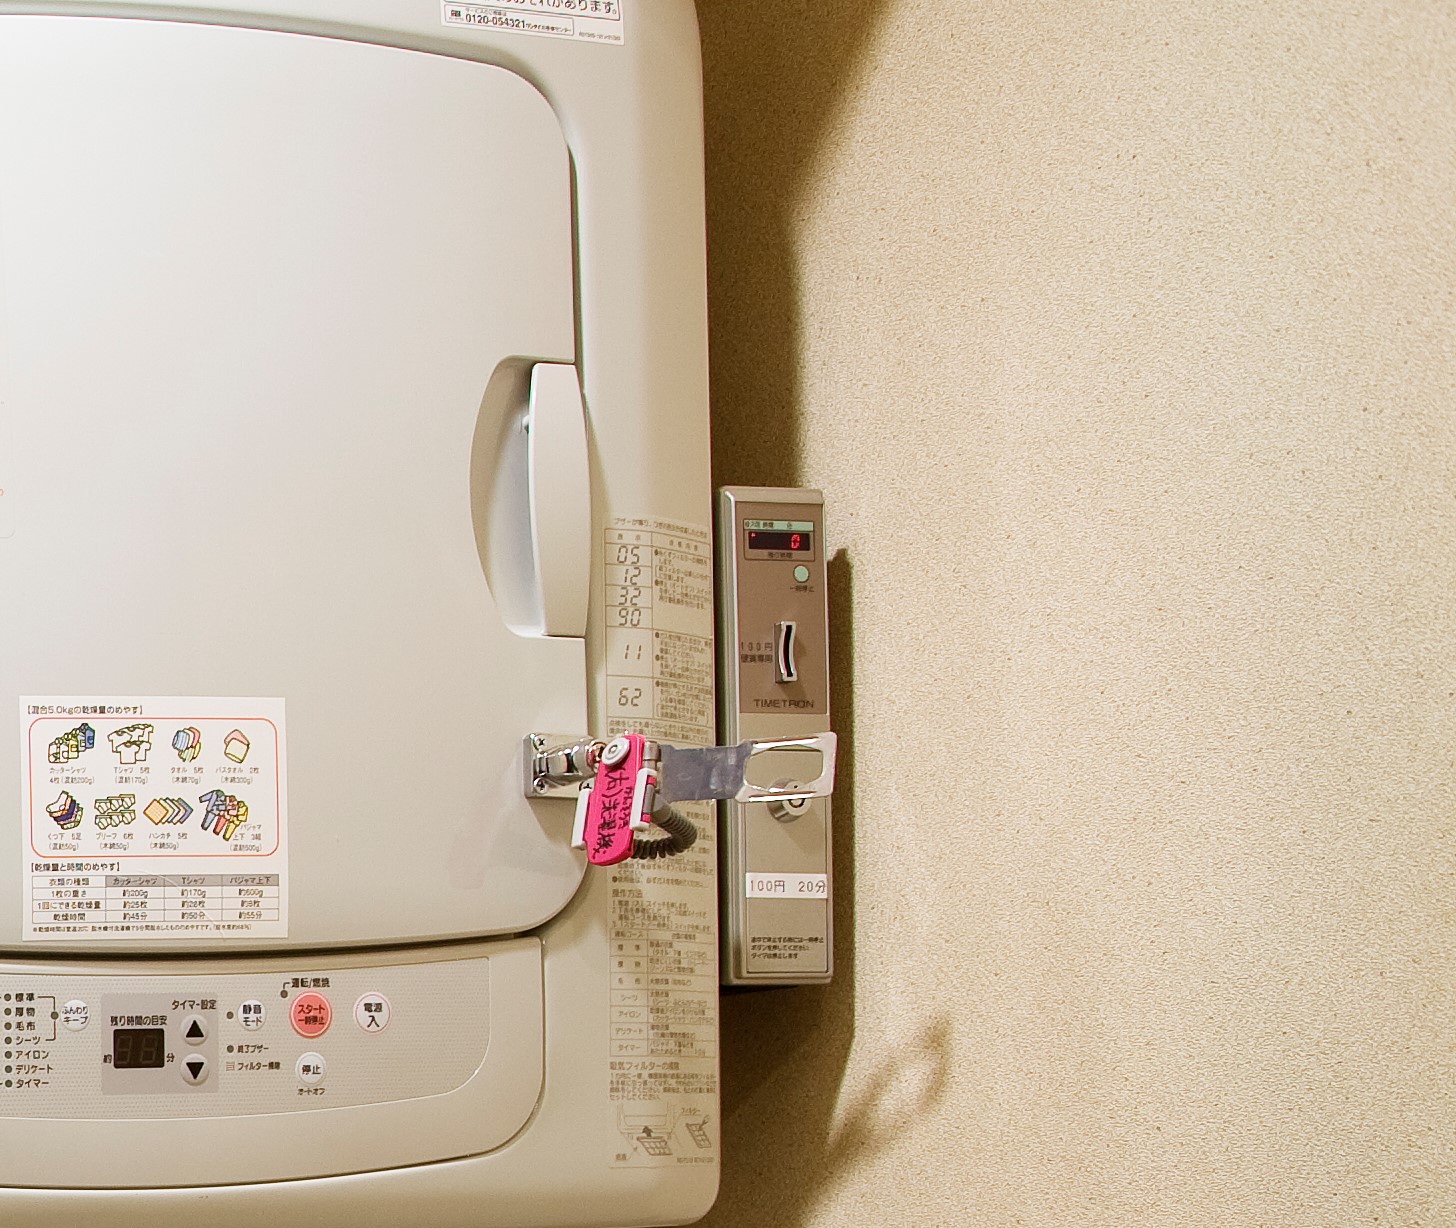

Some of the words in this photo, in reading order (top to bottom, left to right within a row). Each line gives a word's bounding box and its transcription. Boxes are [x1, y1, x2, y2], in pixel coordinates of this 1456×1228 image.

[617, 546, 640, 565] 05
[618, 588, 641, 606] 32
[618, 688, 641, 706] 62
[753, 699, 814, 708] TIMETRON
[751, 880, 785, 892] 100円
[799, 880, 826, 893] 20分
[172, 1000, 216, 1010] タイマー設定
[298, 1004, 325, 1014] スタート
[364, 1002, 382, 1013] 電源
[110, 1016, 167, 1026] 残り時間の目安
[243, 1017, 262, 1026] モード
[366, 1016, 380, 1028] 入
[16, 1036, 41, 1044] シーツ
[16, 1051, 49, 1059] アイロン
[16, 1065, 53, 1073] デリケート
[302, 1064, 321, 1075] 停止
[16, 1079, 49, 1088] タイマー
